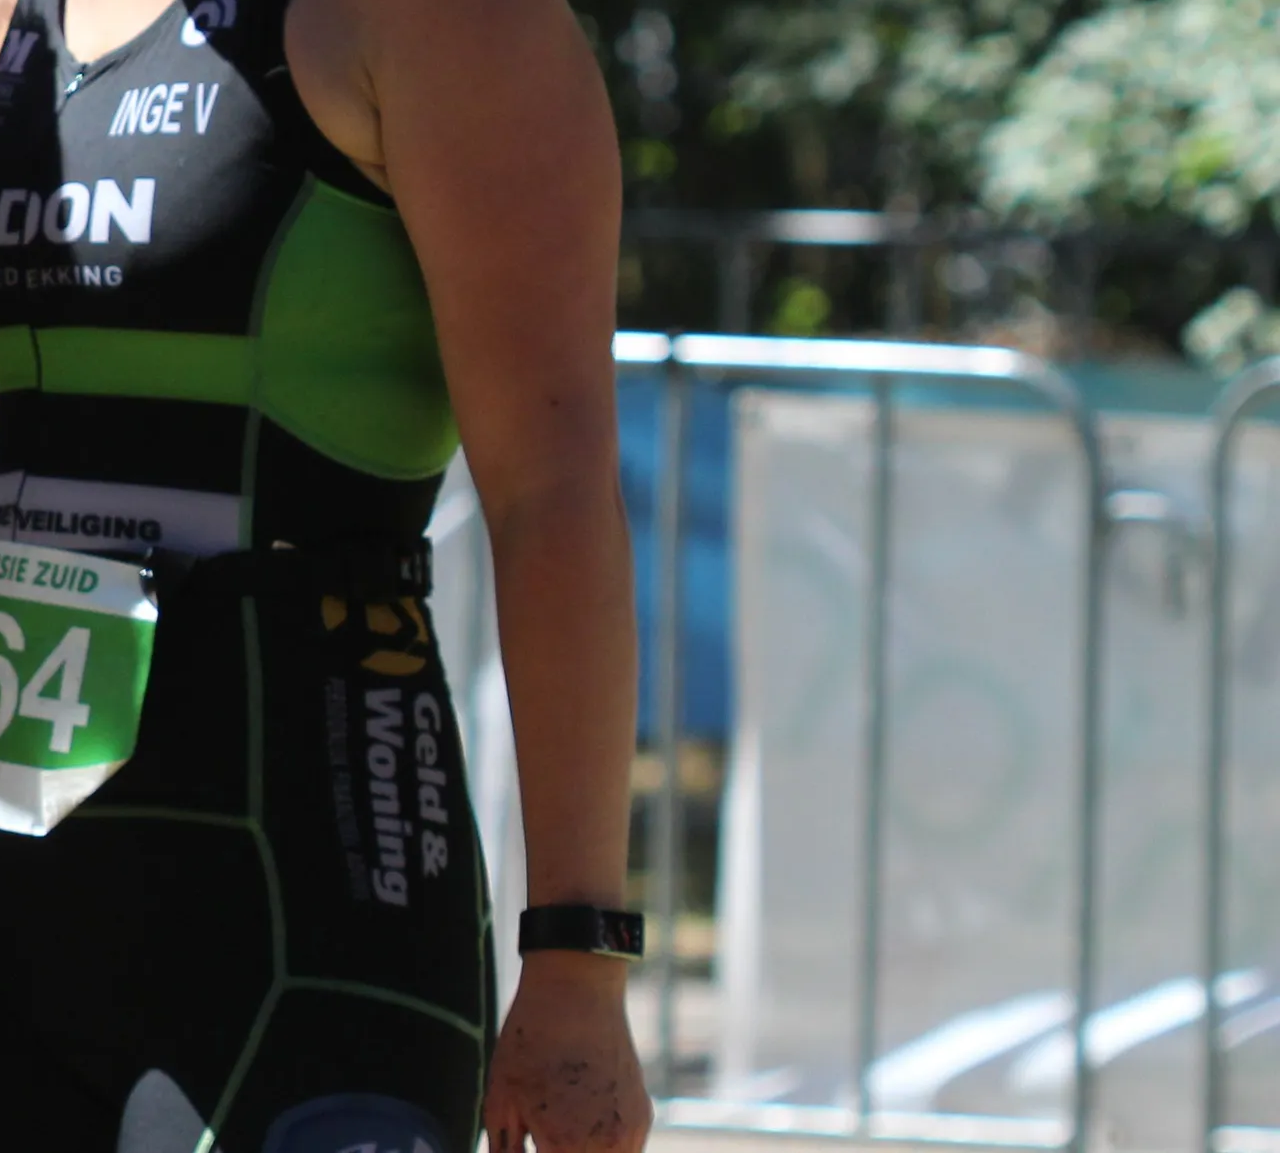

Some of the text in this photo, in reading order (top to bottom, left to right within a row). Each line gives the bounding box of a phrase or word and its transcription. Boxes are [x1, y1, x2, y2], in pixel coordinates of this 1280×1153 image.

[108, 82, 220, 137] INGE V
[33, 561, 99, 593] ZUID
[364, 688, 413, 907] Woning
[413, 691, 448, 879] Geld &
